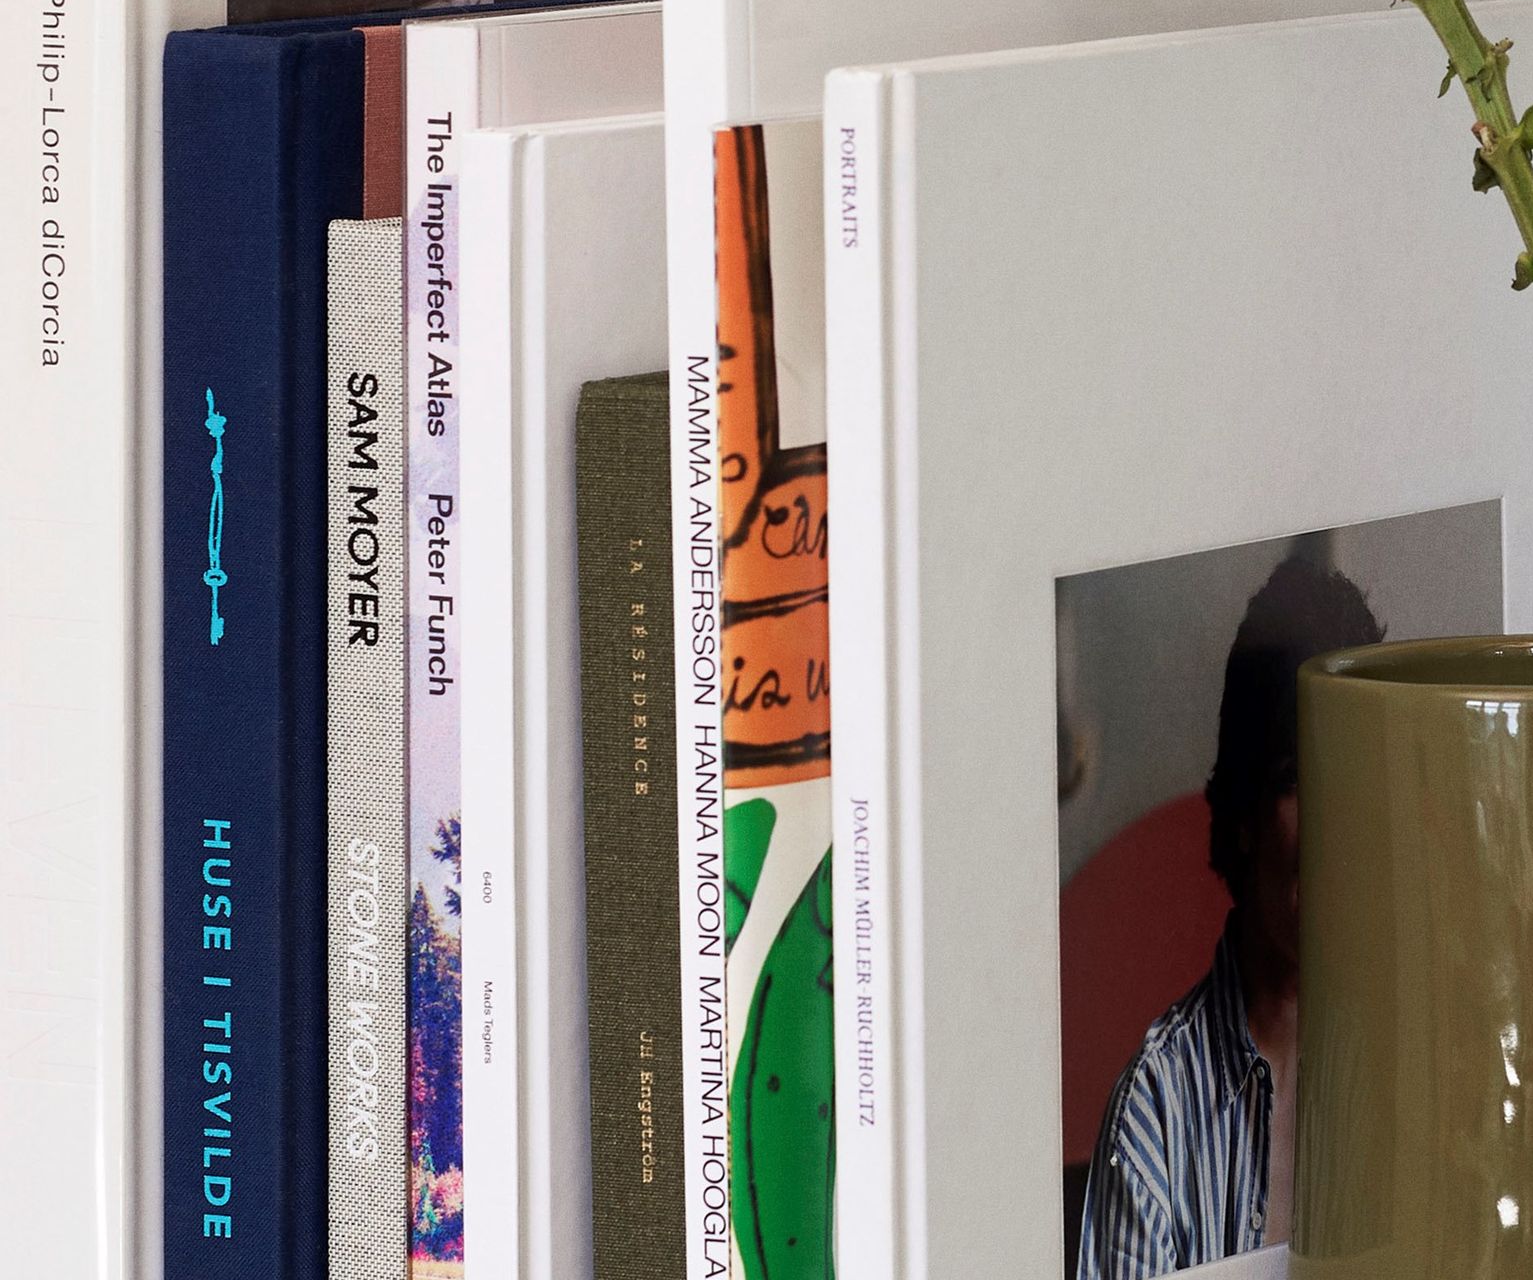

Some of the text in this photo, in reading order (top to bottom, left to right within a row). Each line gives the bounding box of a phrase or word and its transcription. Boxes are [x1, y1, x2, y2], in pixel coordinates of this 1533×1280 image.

[840, 127, 858, 250] PORTRAITS
[41, 219, 66, 368] diCorcia
[420, 111, 453, 438] The Imperfect Atlas
[686, 356, 711, 489] MAMMA
[344, 371, 379, 649] SAM MOYER
[427, 493, 454, 697] Peter Funch
[629, 538, 648, 796] LA RÉSIDENCE
[689, 497, 716, 707] ANDERSSON
[693, 725, 719, 842] HANNA
[850, 798, 871, 892] JOACHIM
[481, 871, 493, 905] 6400
[695, 852, 721, 958] MOON
[202, 818, 232, 1240] HUSE I TISVILDE
[344, 838, 381, 1162] STONE WORKS
[481, 980, 494, 1065] Mads Teglers
[698, 976, 724, 1125] MARTINA
[635, 1030, 658, 1185] JH Engström
